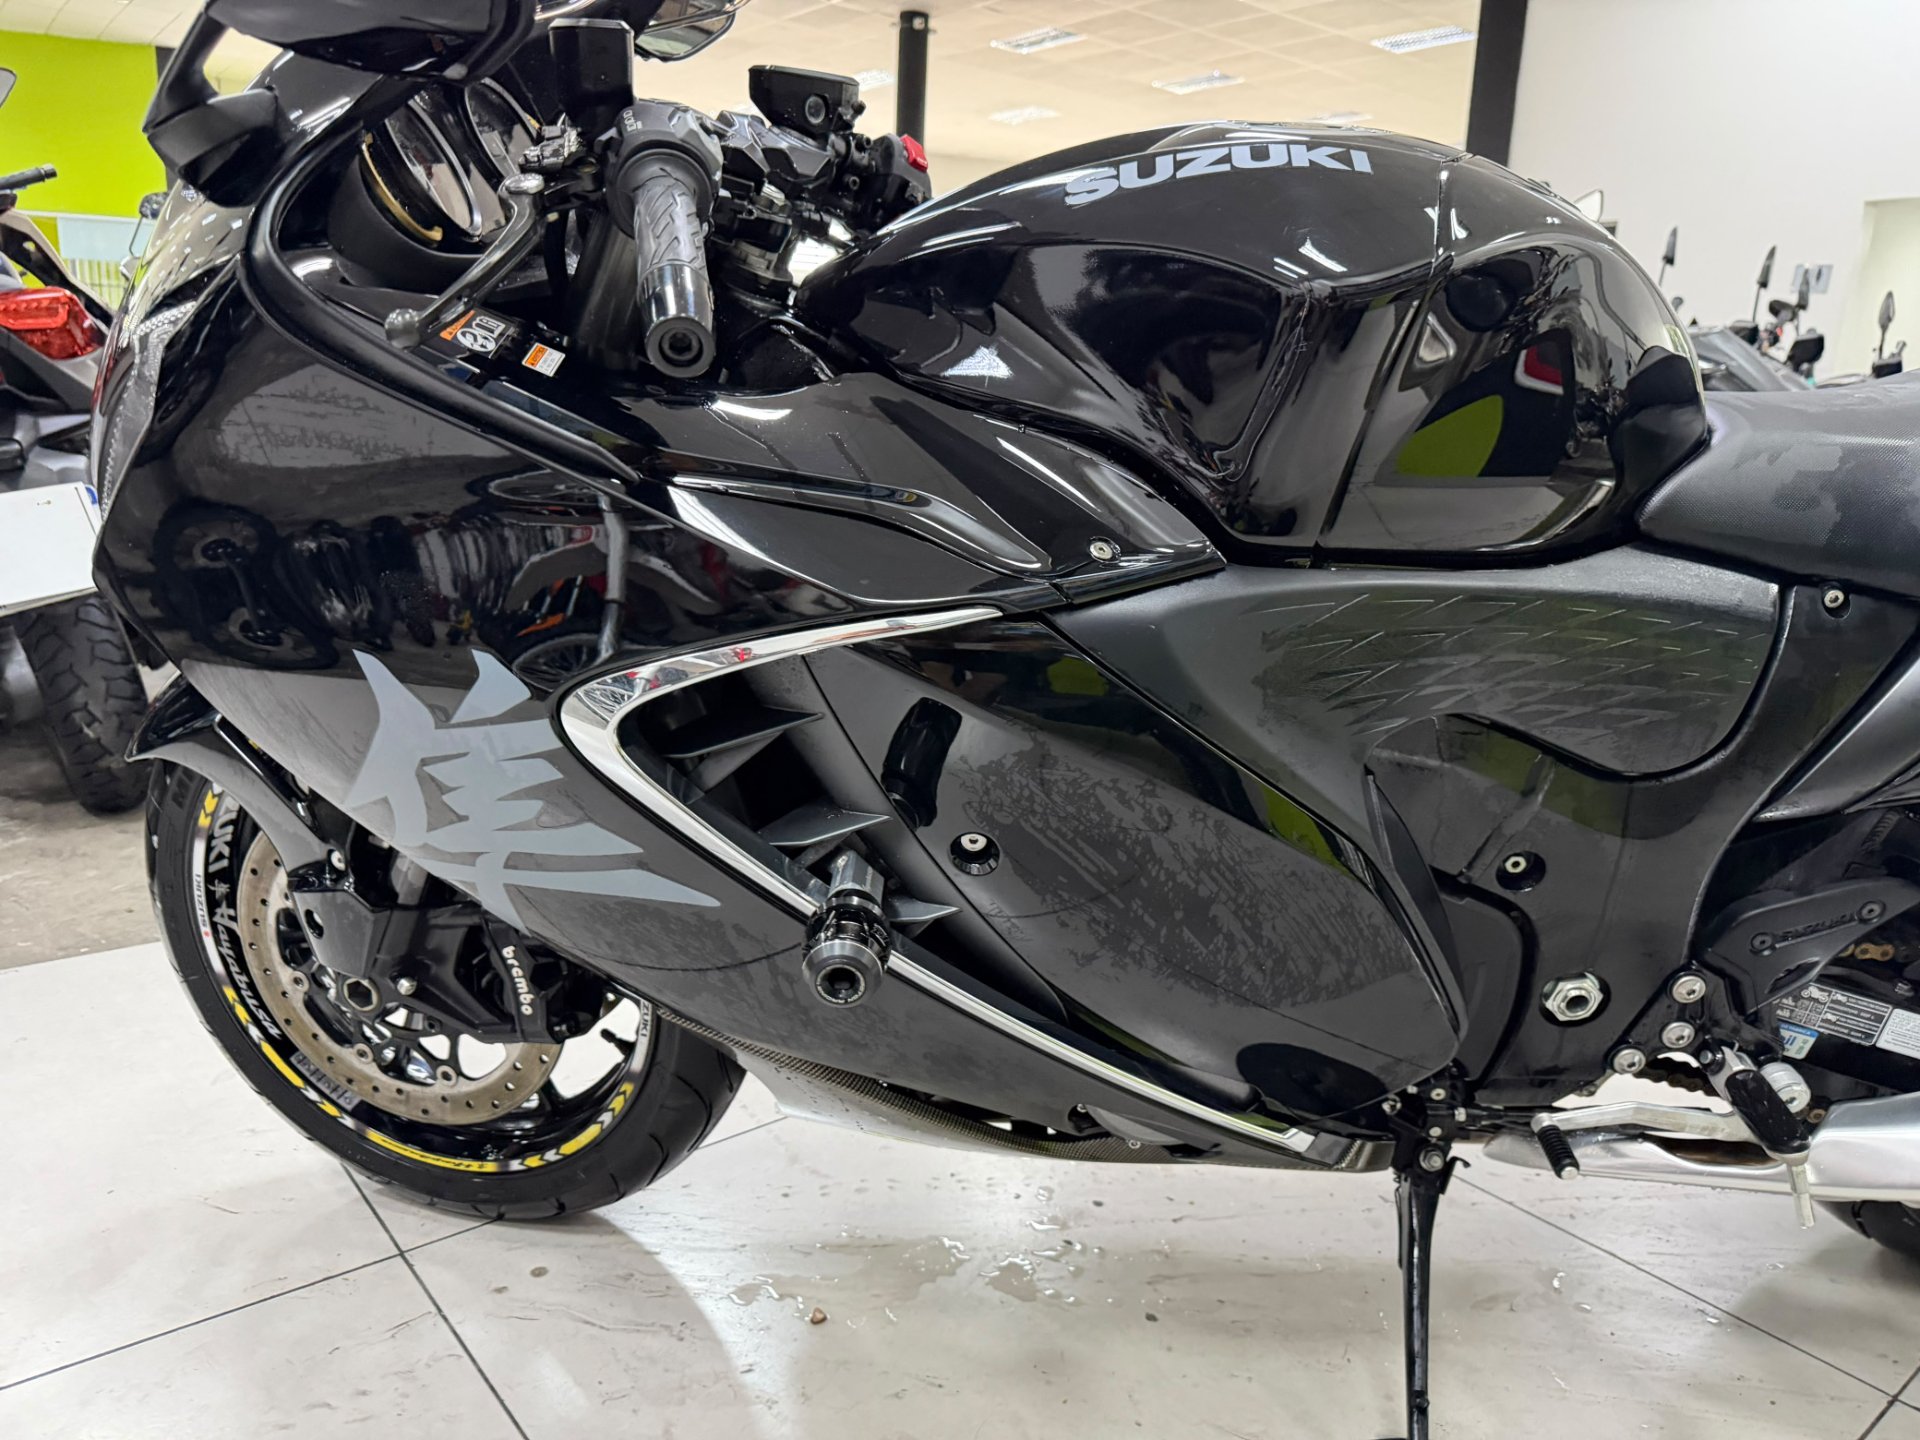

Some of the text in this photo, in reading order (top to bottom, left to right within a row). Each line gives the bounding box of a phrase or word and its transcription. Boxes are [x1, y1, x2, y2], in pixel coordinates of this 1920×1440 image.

[1064, 143, 1374, 206] SUZUKI
[208, 796, 241, 874] ZUKI
[194, 873, 208, 928] SUZUKI
[212, 900, 285, 1041] Hayabusa
[502, 945, 535, 1016] brembo
[640, 1000, 650, 1037] ZUKI
